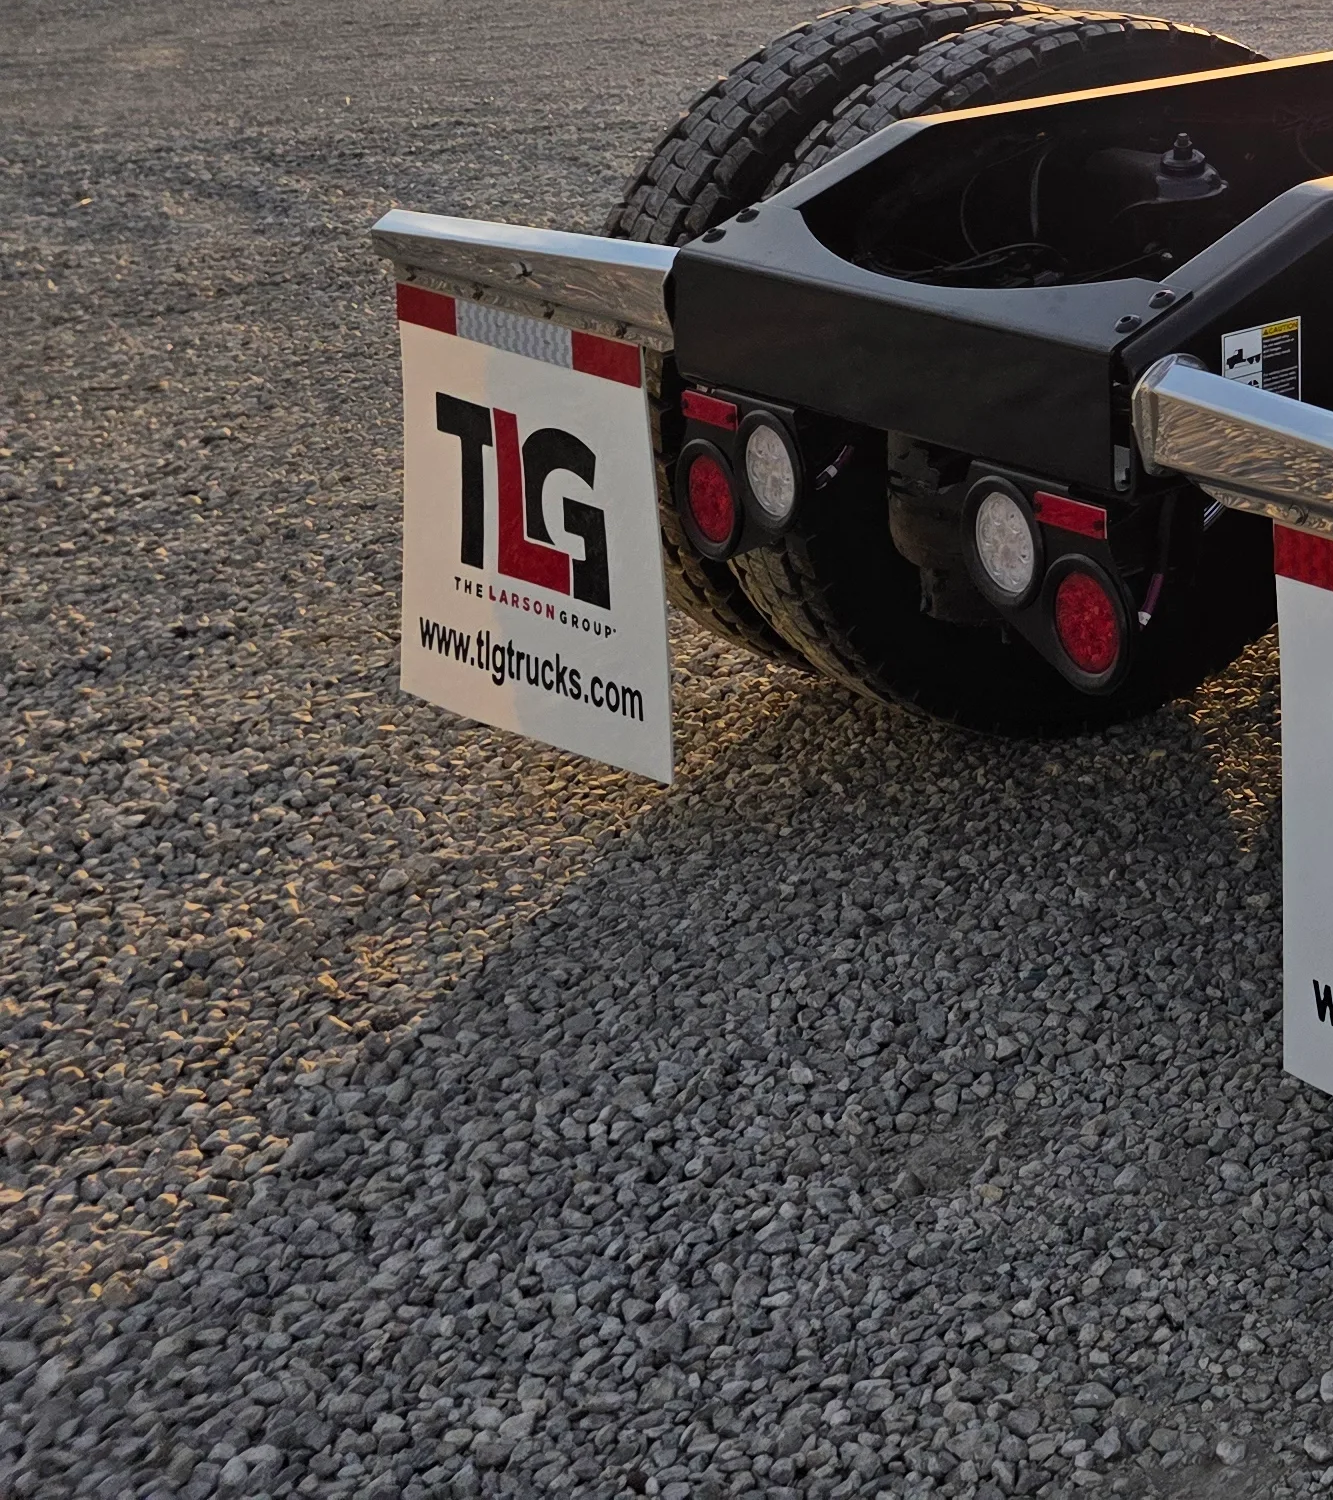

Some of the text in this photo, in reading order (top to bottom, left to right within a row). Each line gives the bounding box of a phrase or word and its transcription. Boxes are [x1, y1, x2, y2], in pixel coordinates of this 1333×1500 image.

[1268, 322, 1298, 334] CAUTION
[436, 392, 611, 610] TLG
[454, 577, 612, 639] THE LARSON GROUP
[419, 616, 644, 722] www.tlgtrucks.com
